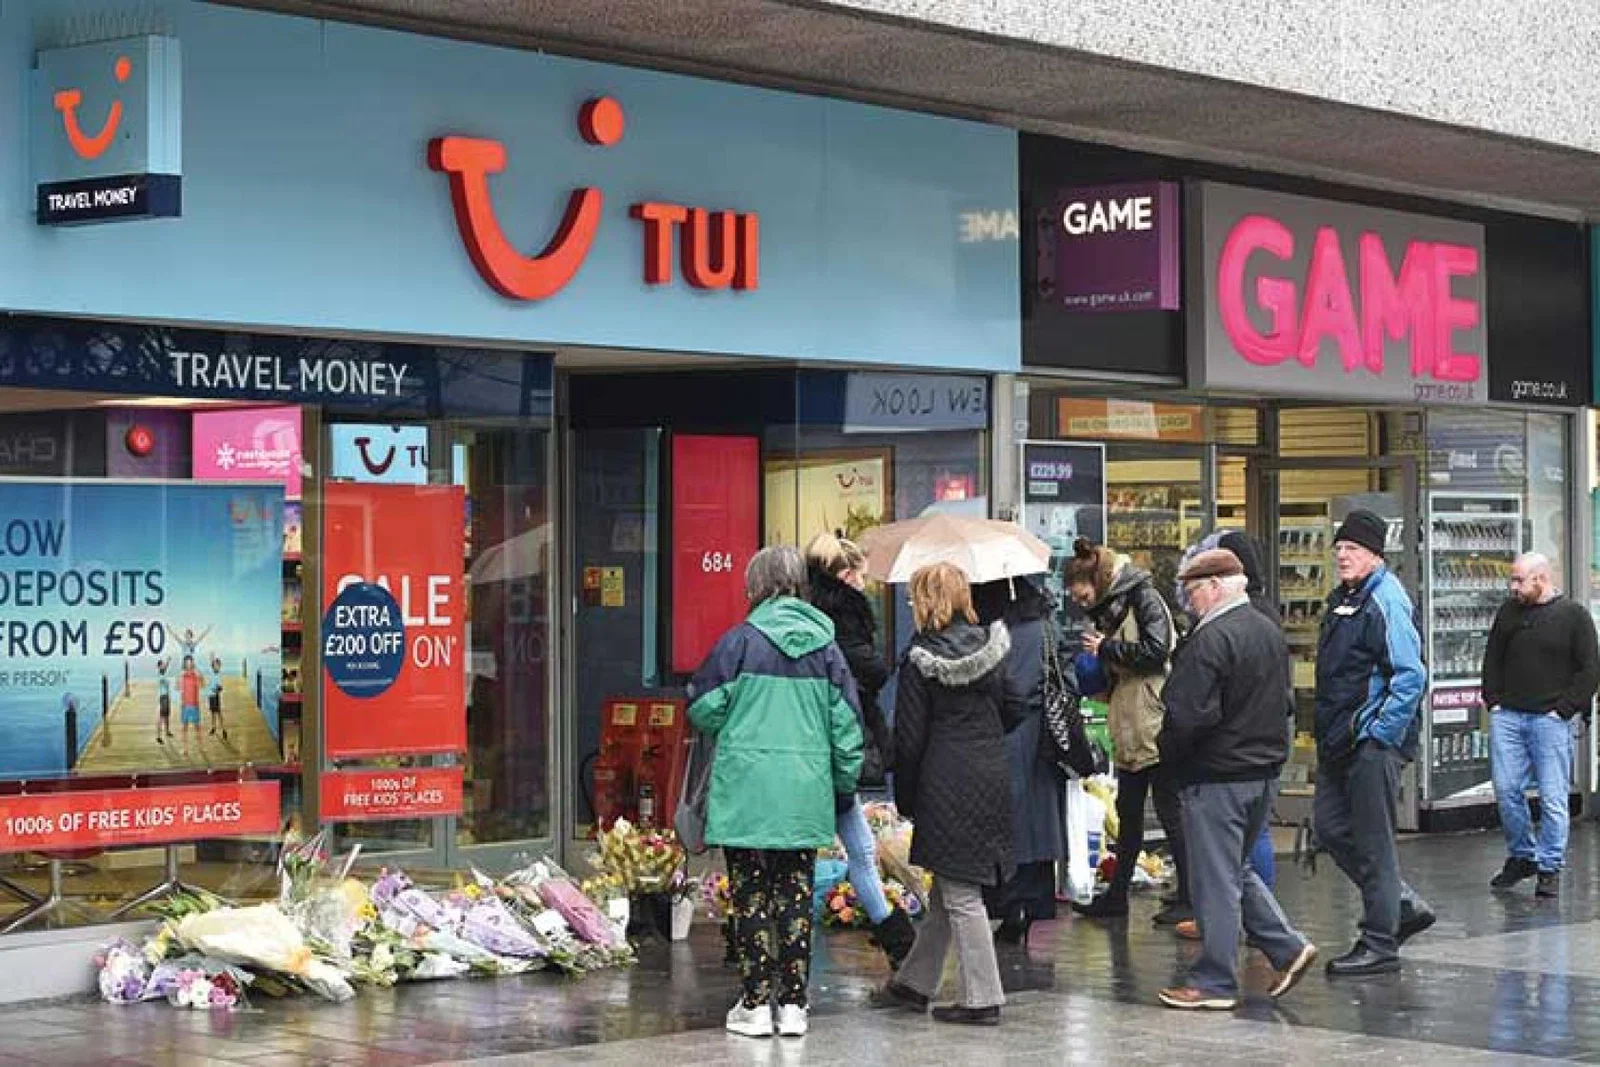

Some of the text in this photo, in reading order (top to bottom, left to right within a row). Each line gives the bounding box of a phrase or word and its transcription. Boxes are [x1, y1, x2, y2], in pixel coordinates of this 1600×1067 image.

[48, 186, 137, 211] TRAVEL MONEY
[1063, 196, 1153, 235] GAME
[629, 202, 758, 291] TUI
[1219, 214, 1481, 382] GAME
[168, 352, 408, 397] TRAVEL MONEY
[1511, 380, 1568, 400] game.co.uk
[0, 518, 66, 557] OW
[702, 551, 733, 573] 684
[334, 605, 392, 629] EXTRA
[336, 574, 452, 627] LE
[0, 619, 166, 657] ROM £50
[324, 631, 403, 657] £200 OFF
[343, 792, 371, 807] FREE
[402, 789, 443, 804] PLACES
[6, 815, 54, 836] 1000s
[58, 812, 84, 832] OF
[88, 809, 131, 830] FREE
[182, 802, 242, 823] PLACES
